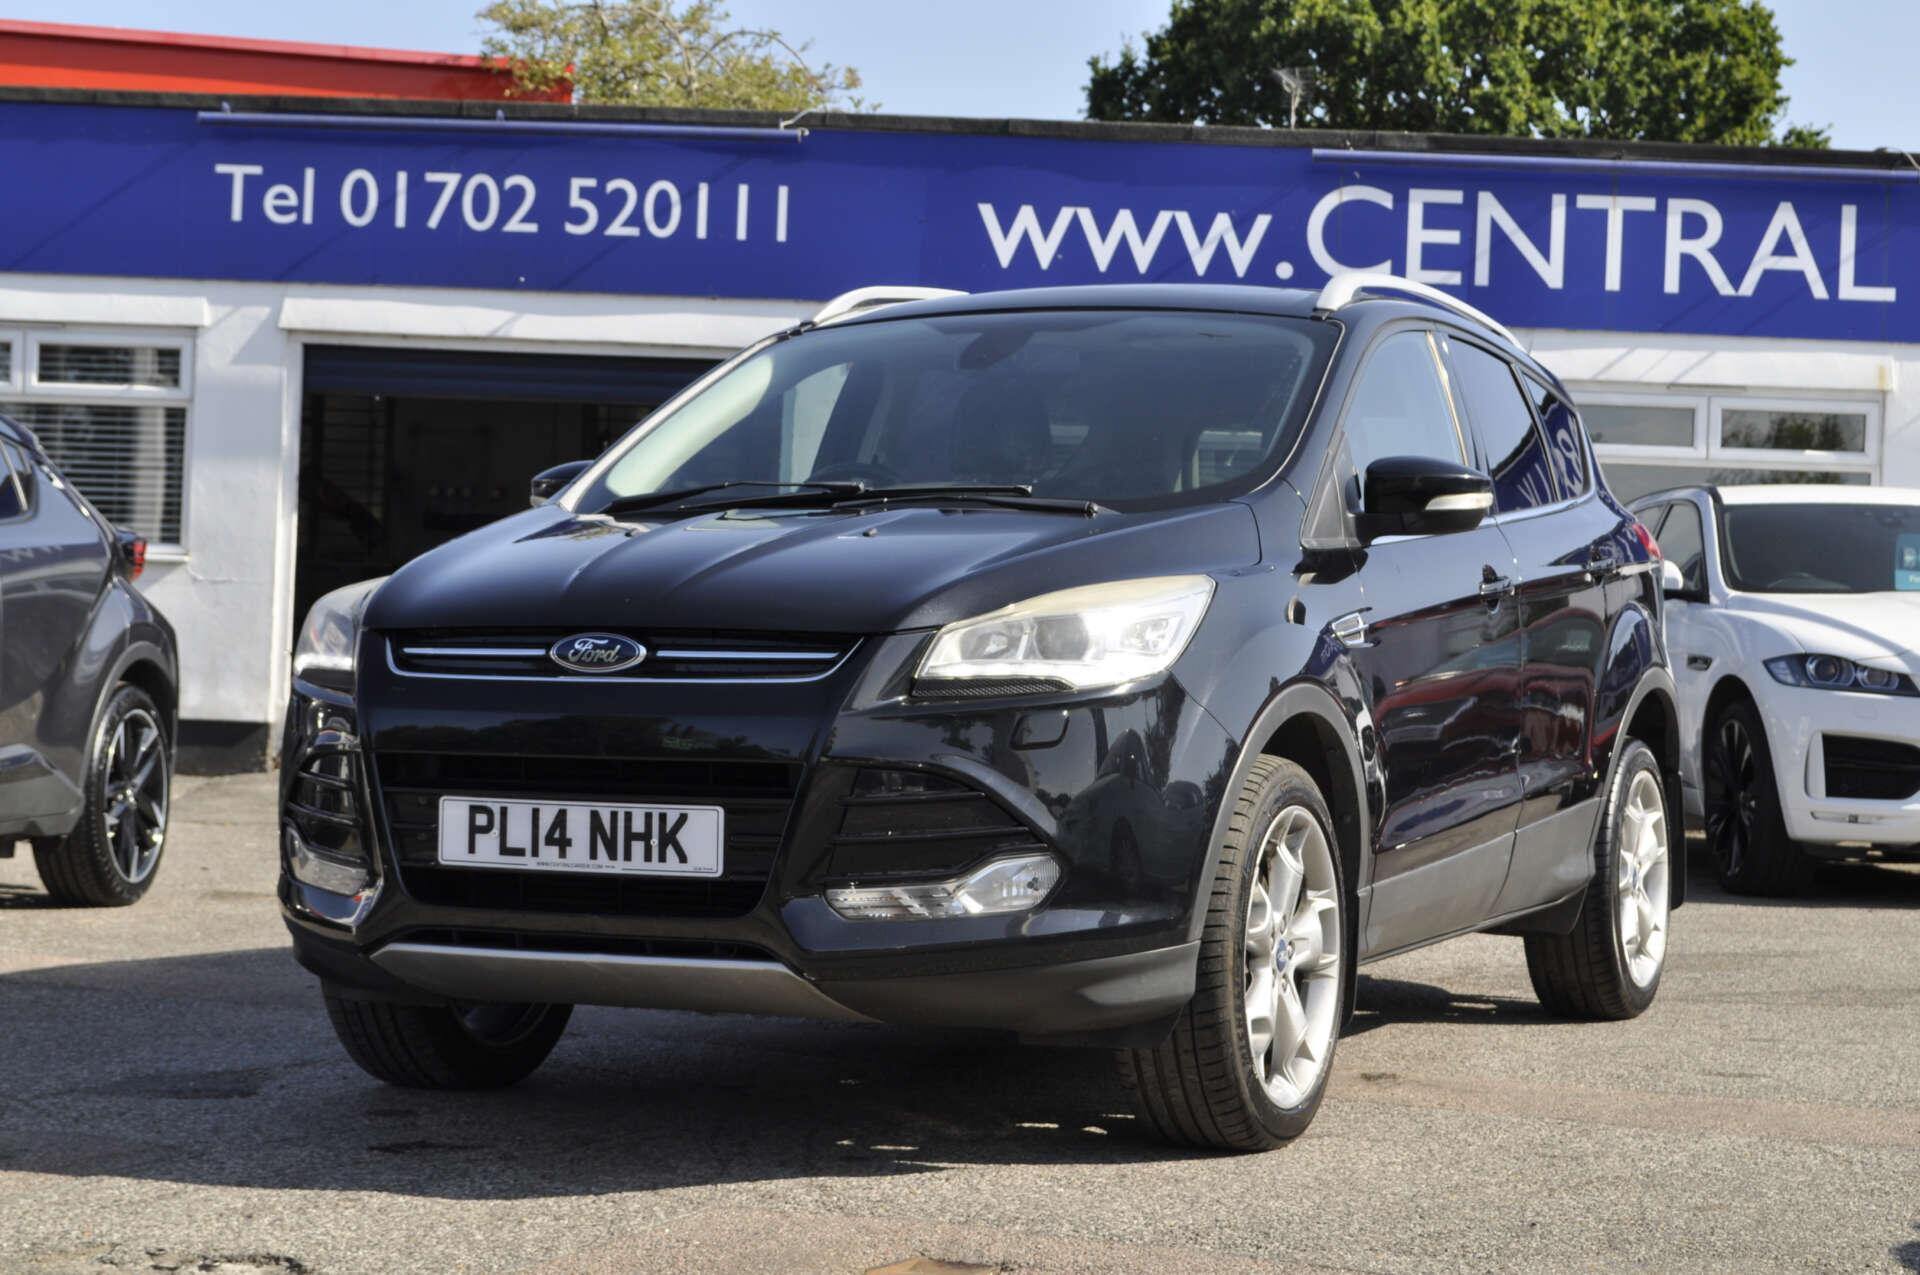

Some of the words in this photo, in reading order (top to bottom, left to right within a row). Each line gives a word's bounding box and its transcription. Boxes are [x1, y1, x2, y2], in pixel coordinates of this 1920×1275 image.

[215, 163, 315, 225] Tel
[340, 168, 539, 234] 01702
[564, 177, 790, 244] 520111
[568, 638, 622, 663] Ford
[467, 803, 574, 859] PL14
[588, 808, 690, 865] NHK
